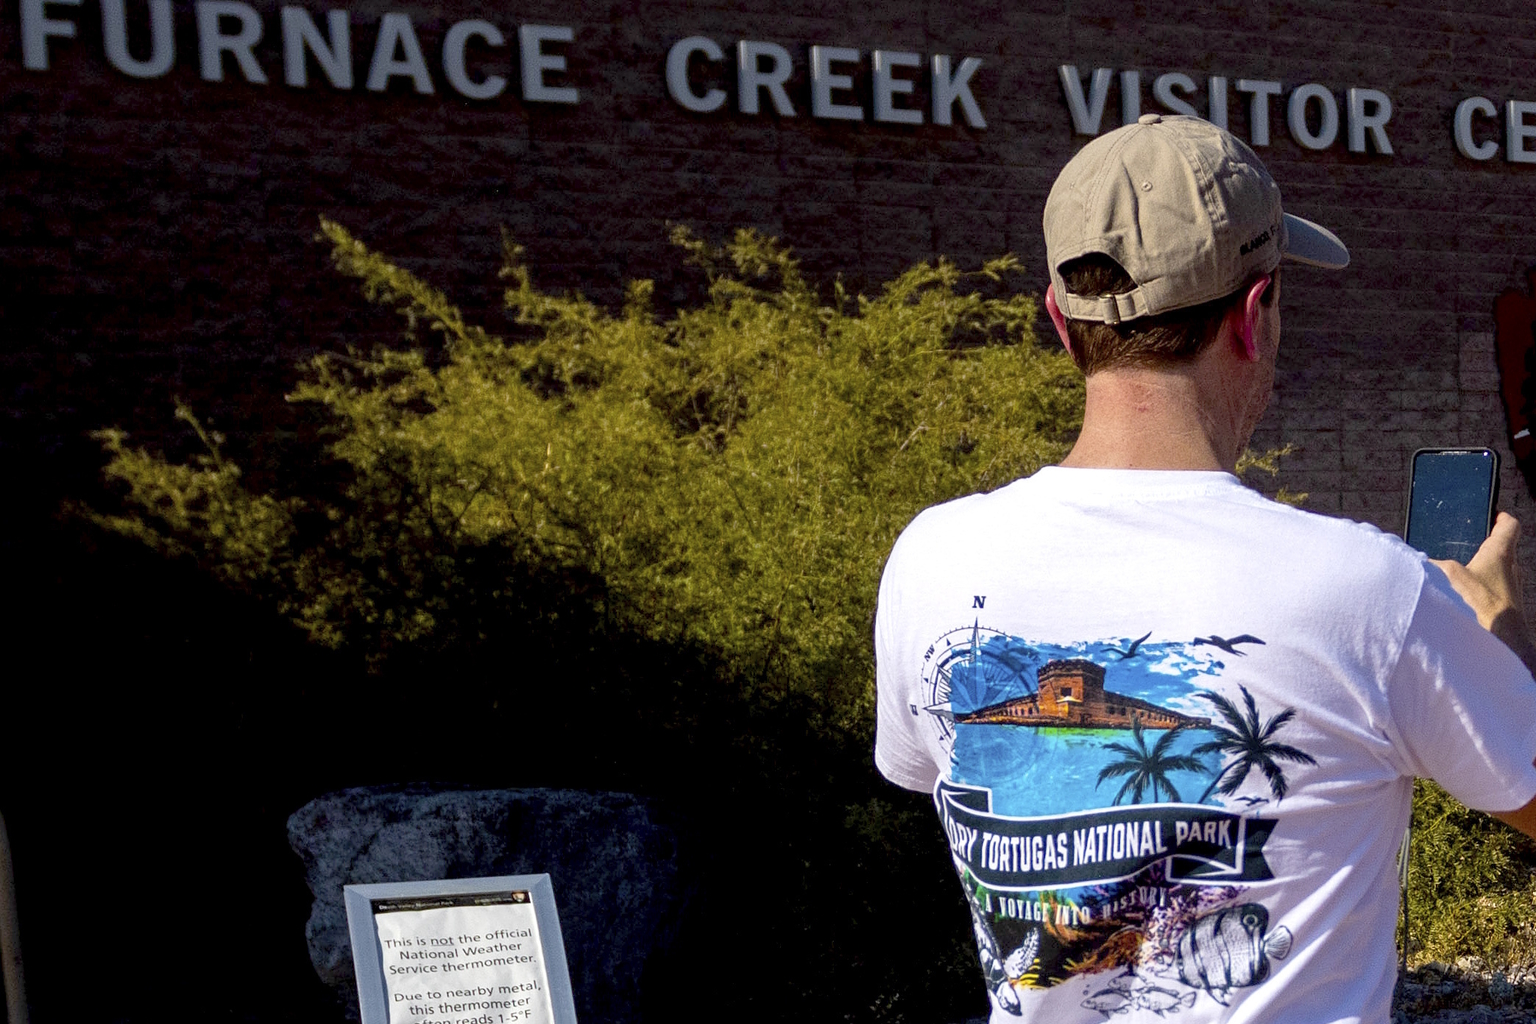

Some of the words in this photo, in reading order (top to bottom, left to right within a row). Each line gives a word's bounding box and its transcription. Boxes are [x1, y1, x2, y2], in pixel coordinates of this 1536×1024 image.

[20, 0, 580, 104] FURNACE
[665, 35, 988, 129] CREEK
[1057, 63, 1395, 155] VISITOR
[972, 595, 987, 609] N
[948, 815, 978, 863] DRY
[980, 830, 1068, 872] TORTUGAS
[1073, 820, 1167, 866] NATIONAL
[1175, 819, 1232, 850] PARK
[984, 893, 992, 913] A
[998, 896, 1050, 922] VOYAGE
[1055, 904, 1091, 926] INTO
[1102, 885, 1168, 918] HISTORY
[384, 938, 412, 950] This
[416, 936, 427, 946] is
[430, 936, 455, 946] not
[458, 934, 481, 944] the
[486, 928, 532, 941] official
[400, 948, 458, 960] National
[462, 942, 522, 956] Weather
[389, 964, 438, 976] Service
[442, 955, 537, 973] thermometer.
[394, 992, 422, 1002] Due
[427, 991, 442, 1000] to
[446, 986, 494, 999] nearby
[498, 980, 542, 995] metal,
[409, 1005, 435, 1016] this
[439, 997, 531, 1014] thermometer
[498, 1008, 532, 1024] 1-5°F
